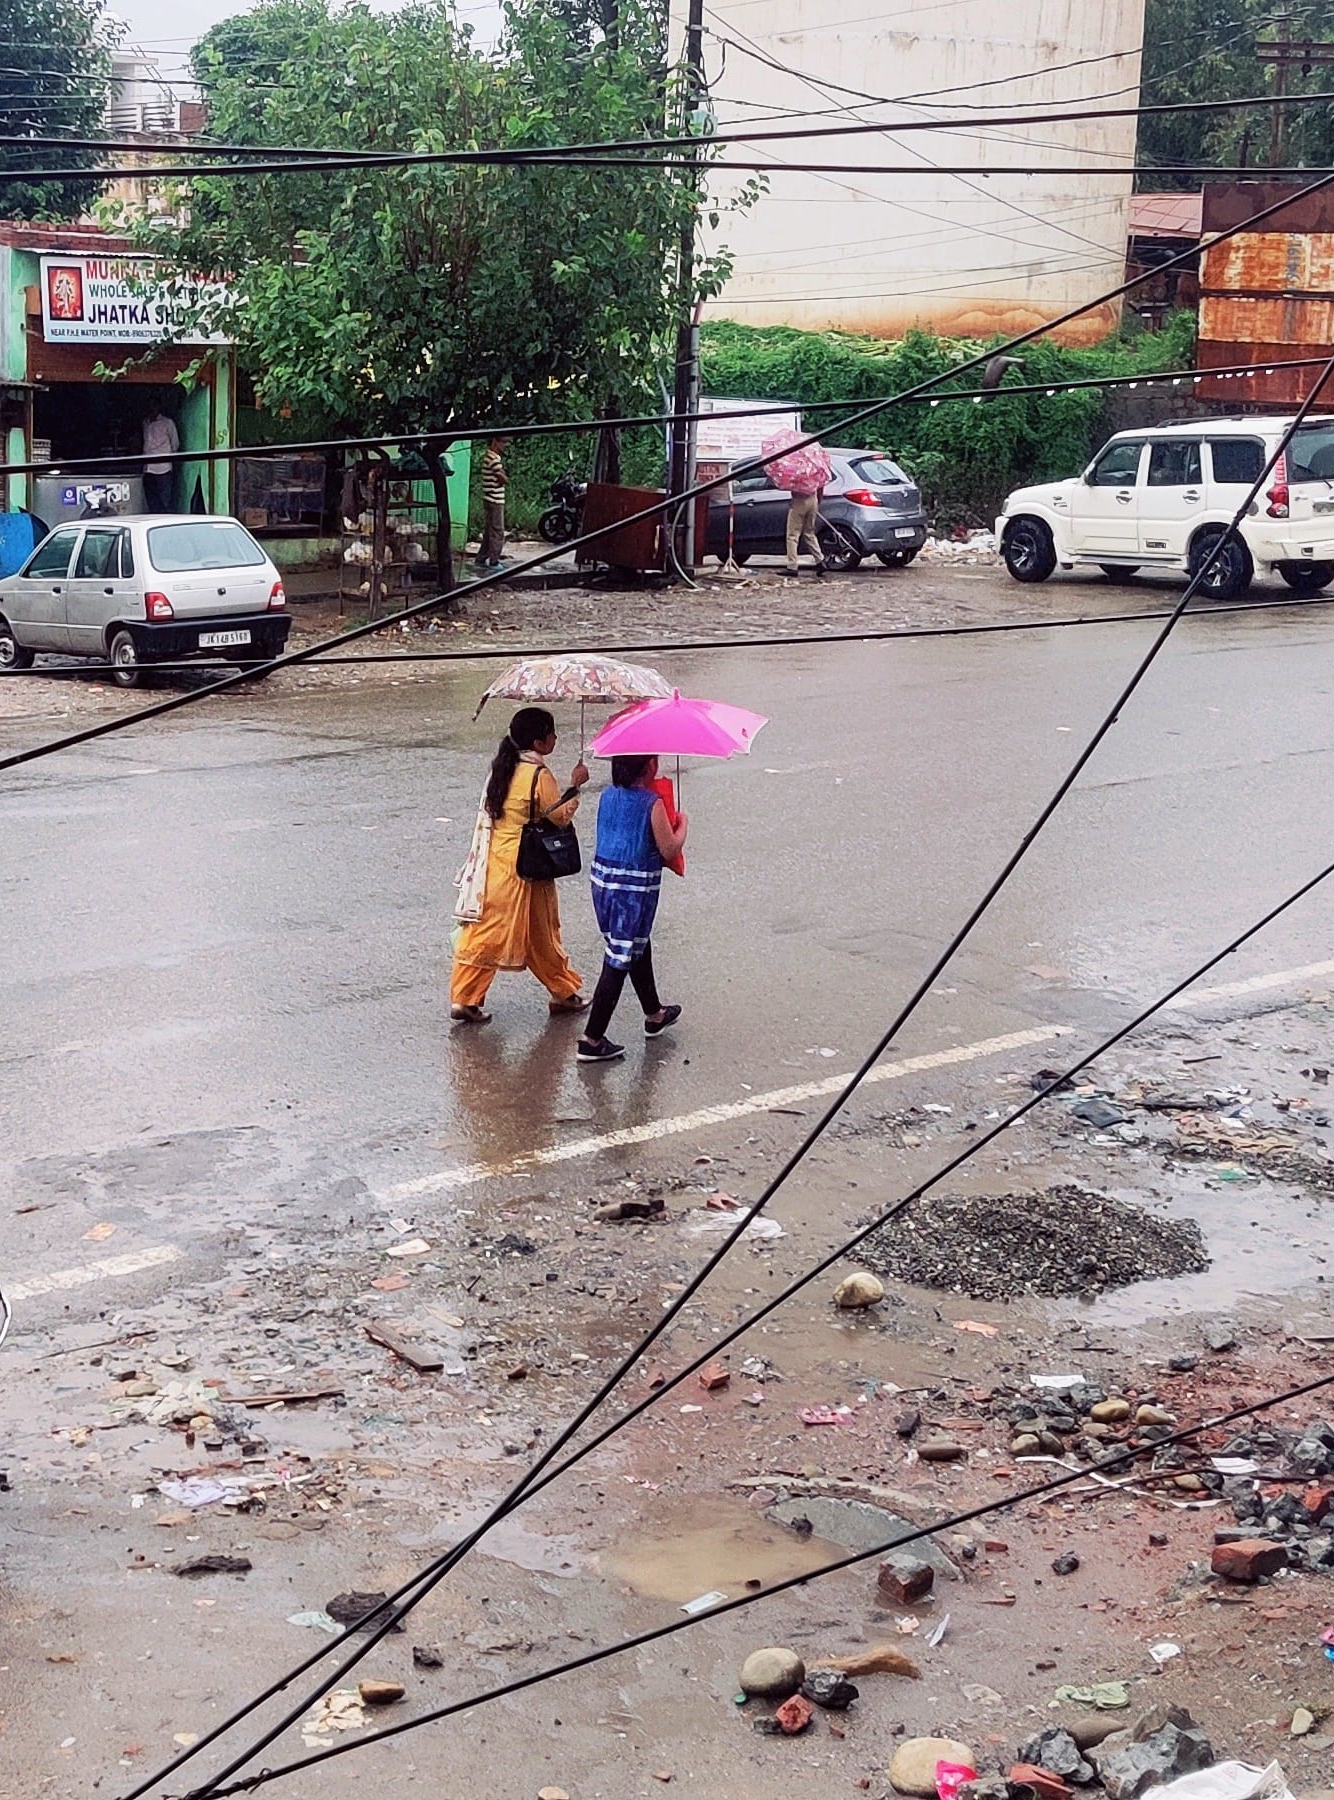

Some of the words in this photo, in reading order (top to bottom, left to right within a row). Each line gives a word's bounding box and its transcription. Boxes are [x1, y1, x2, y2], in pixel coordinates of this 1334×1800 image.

[88, 304, 150, 325] JHATKA
[155, 304, 187, 326] SHO
[50, 328, 66, 337] NEAR
[81, 329, 99, 338] WATER
